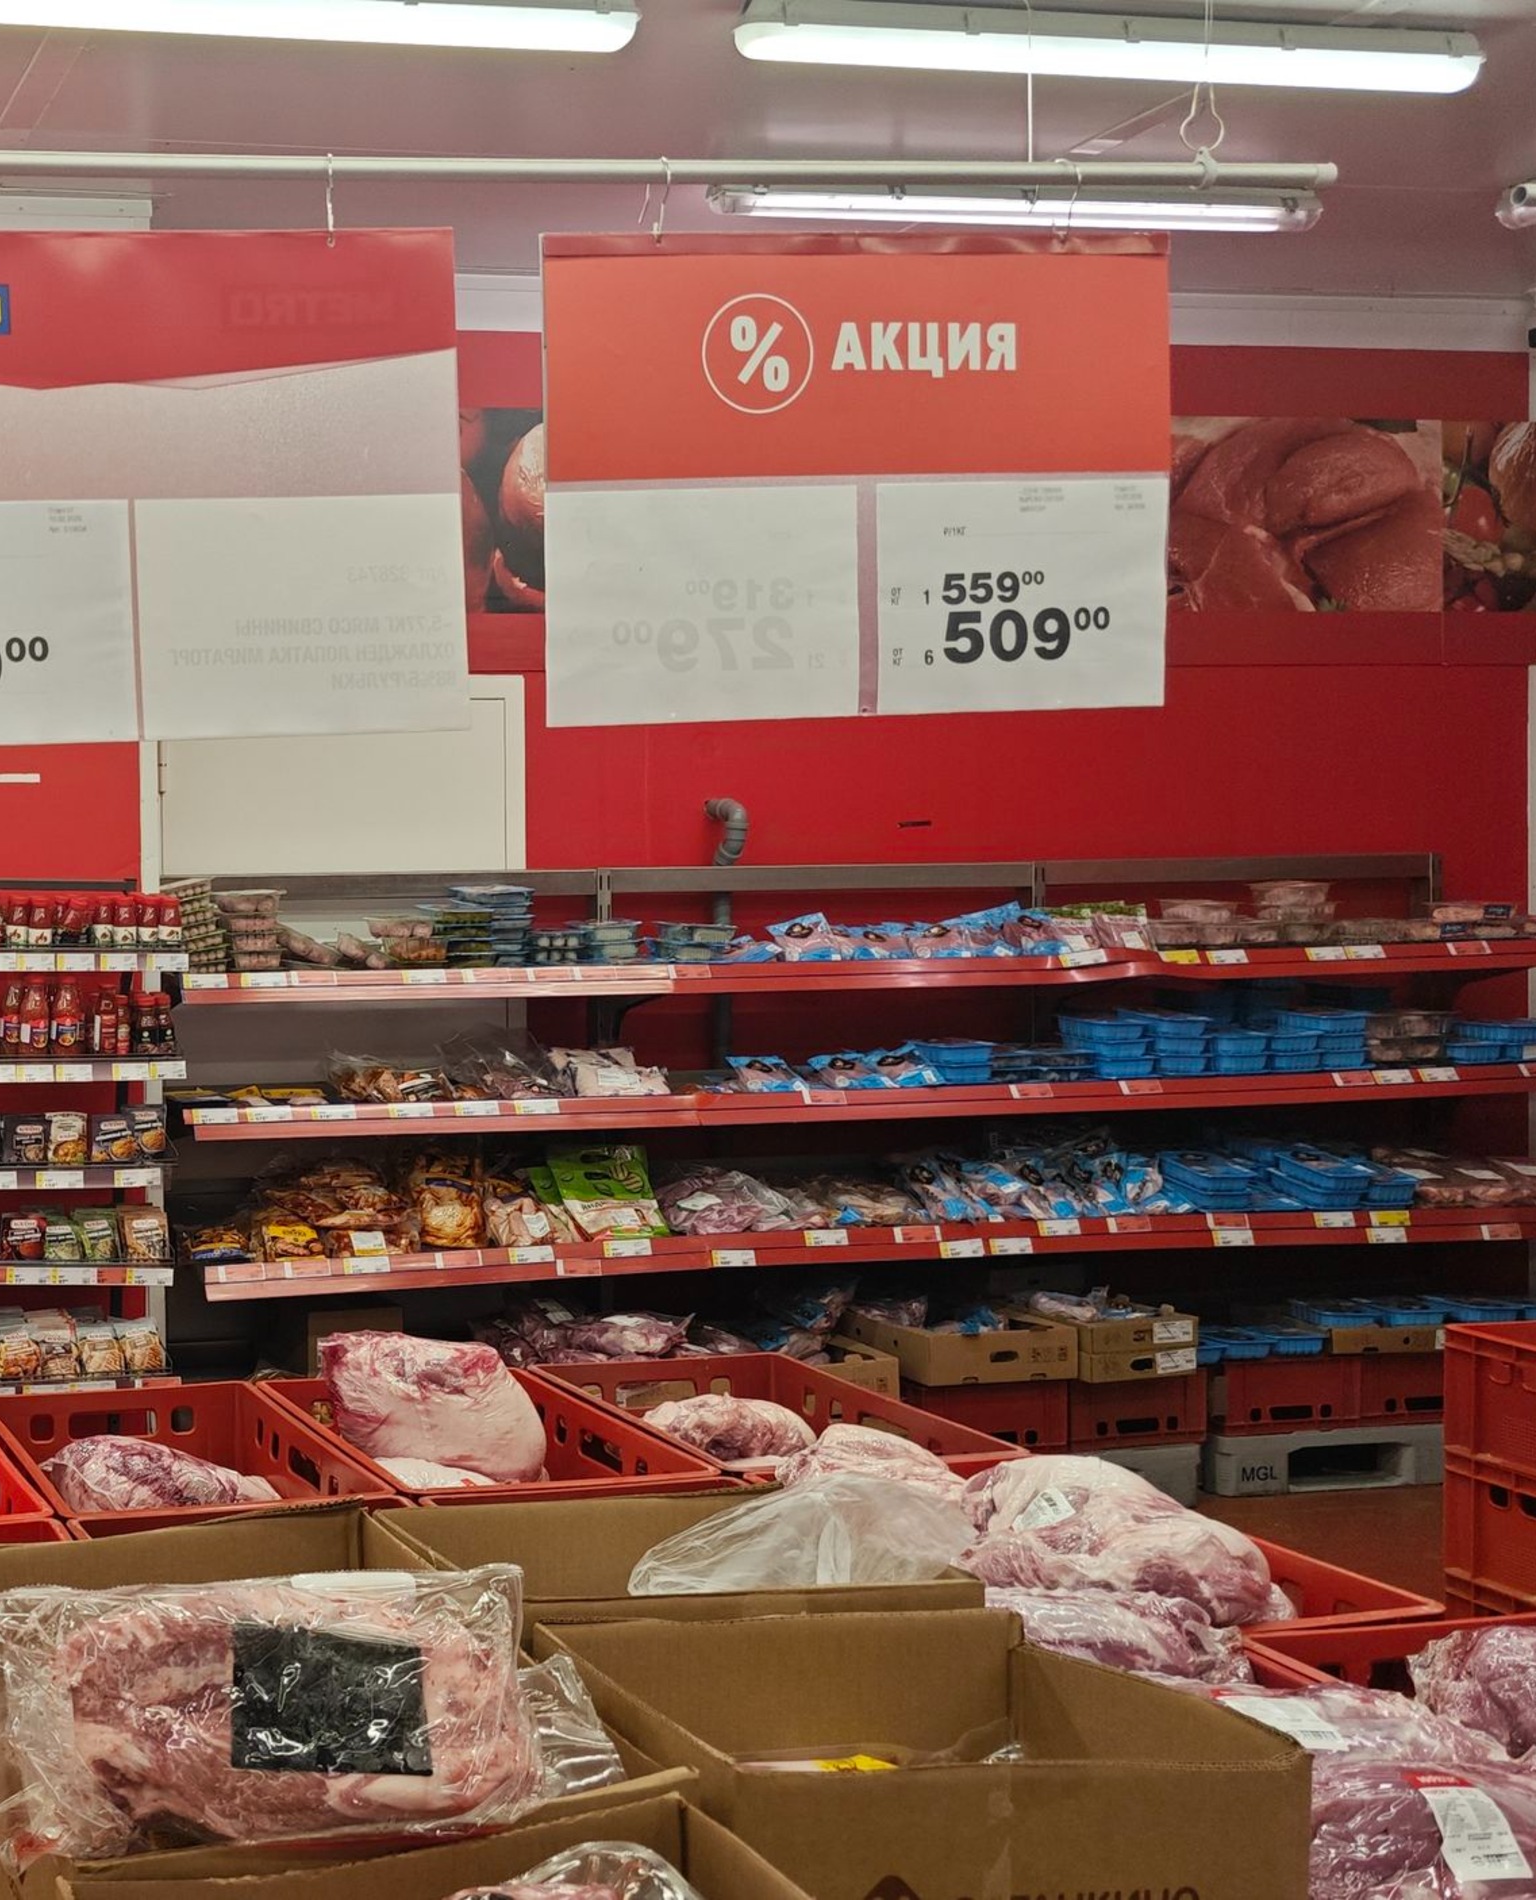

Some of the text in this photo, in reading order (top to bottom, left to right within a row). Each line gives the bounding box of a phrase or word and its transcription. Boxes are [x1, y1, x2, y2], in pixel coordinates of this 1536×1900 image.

[830, 320, 1018, 379] АКЦИЯ
[923, 589, 931, 605] 1
[924, 649, 934, 666] 6
[1241, 1465, 1279, 1482] MGL
